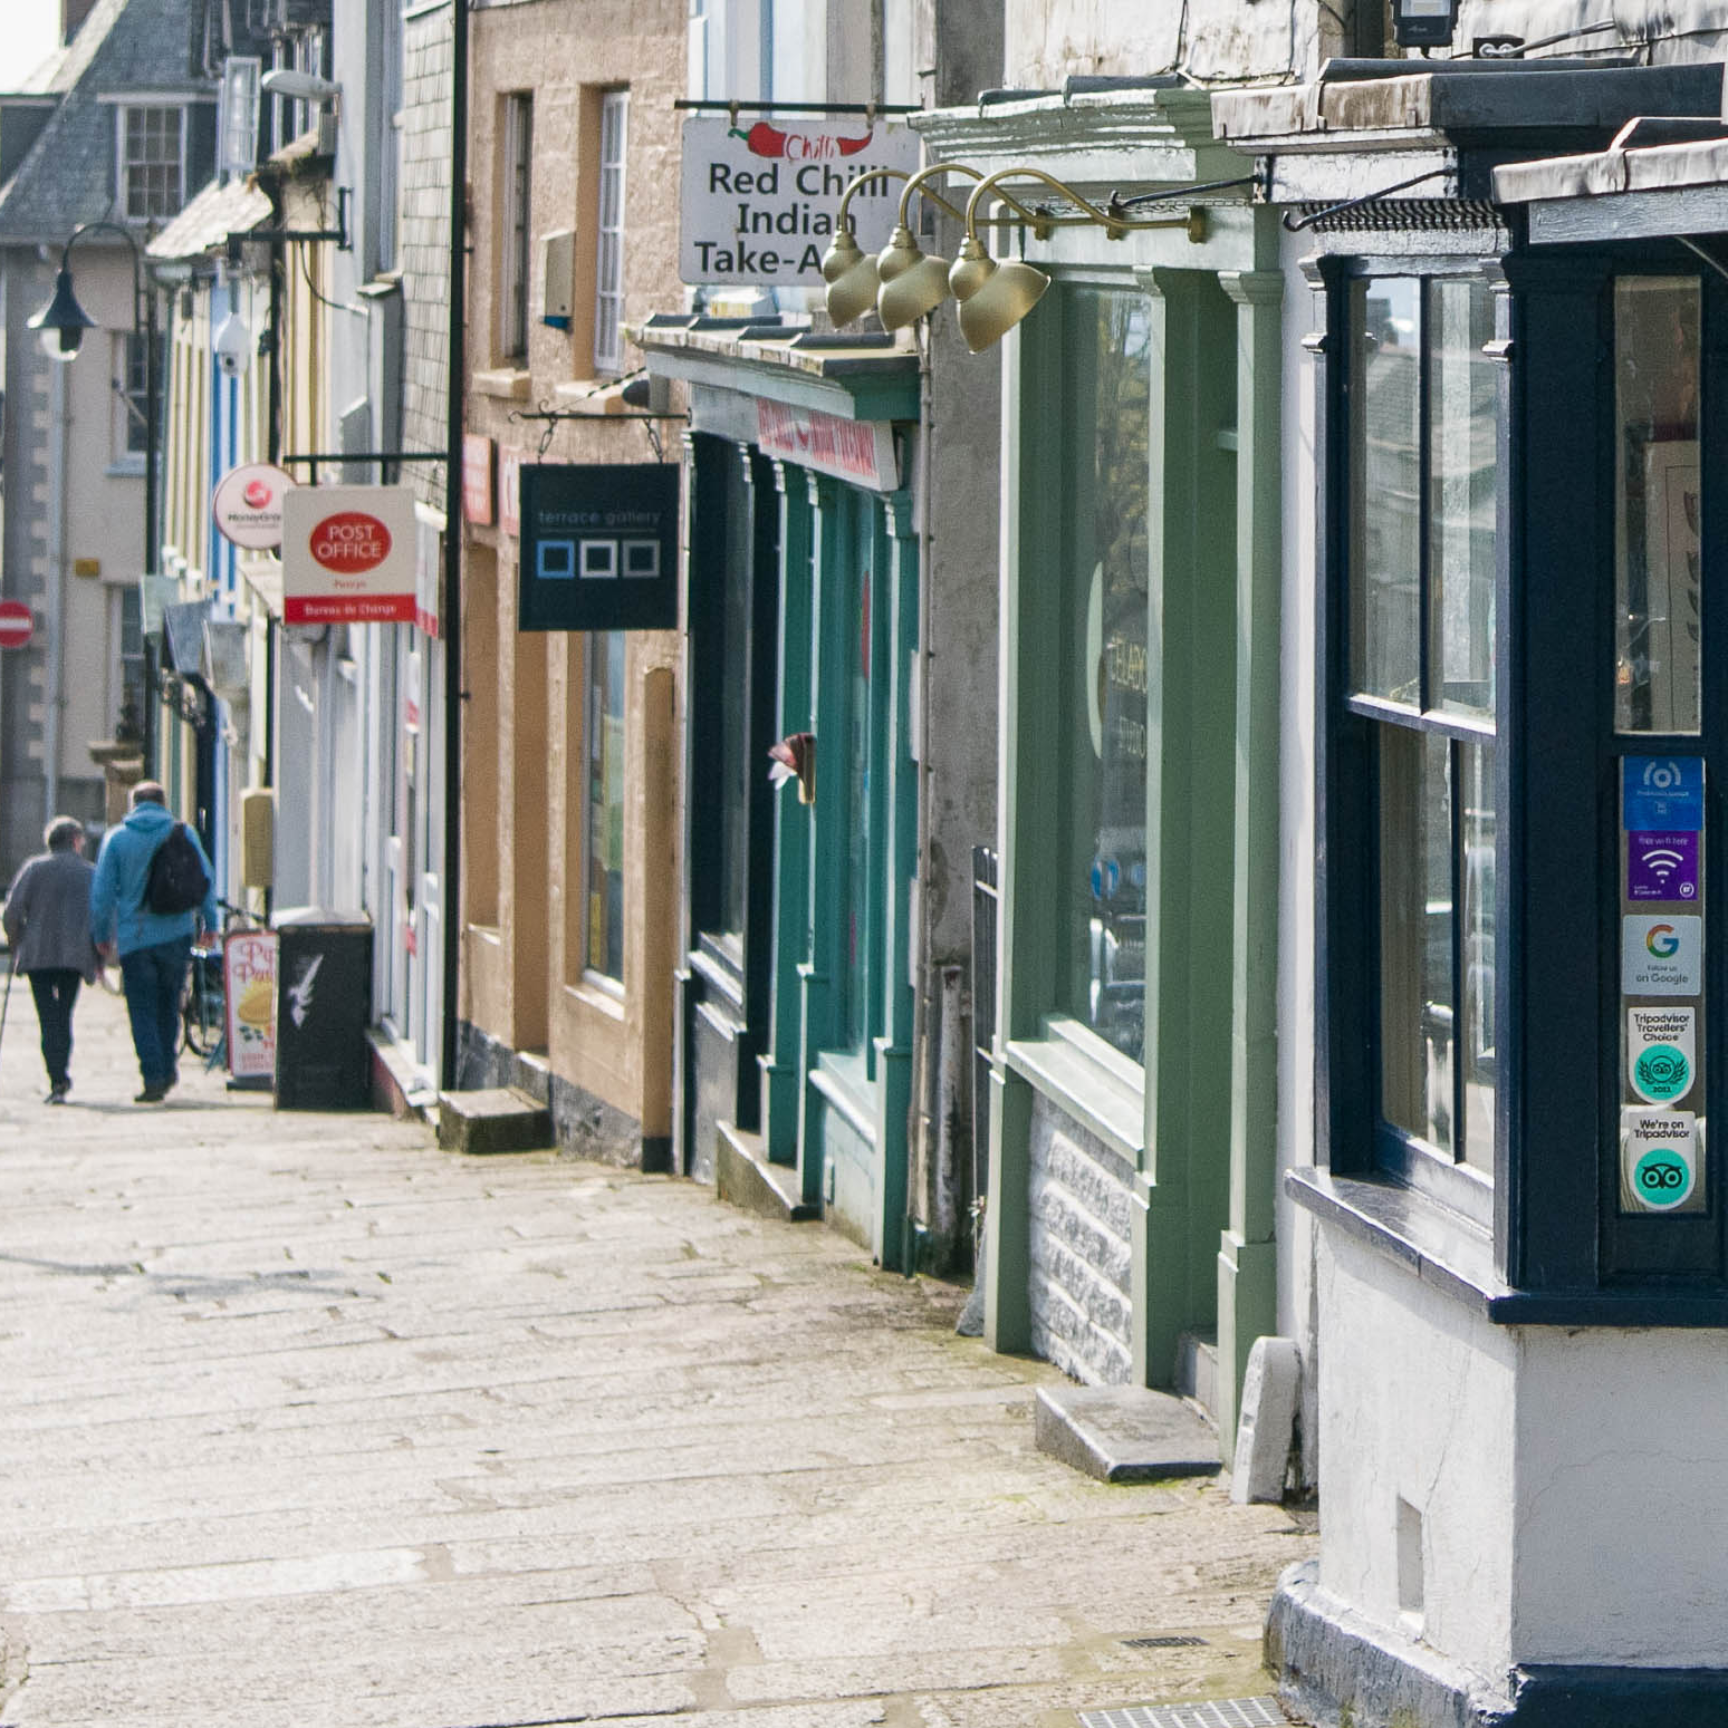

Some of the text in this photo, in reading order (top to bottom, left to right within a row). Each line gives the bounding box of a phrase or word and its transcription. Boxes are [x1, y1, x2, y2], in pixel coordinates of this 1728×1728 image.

[709, 162, 889, 197] Red Chilli
[738, 203, 857, 235] Indian
[694, 241, 822, 274] Take-A
[539, 510, 661, 525] terrace gallery
[329, 525, 376, 541] POST
[317, 541, 382, 559] OFFICE
[1636, 973, 1689, 985] on Google
[1633, 1013, 1690, 1025] Tripadvisor
[1642, 1033, 1679, 1042] Choice
[1639, 1119, 1684, 1130] We're on
[1633, 1129, 1690, 1141] Tripadvisor
